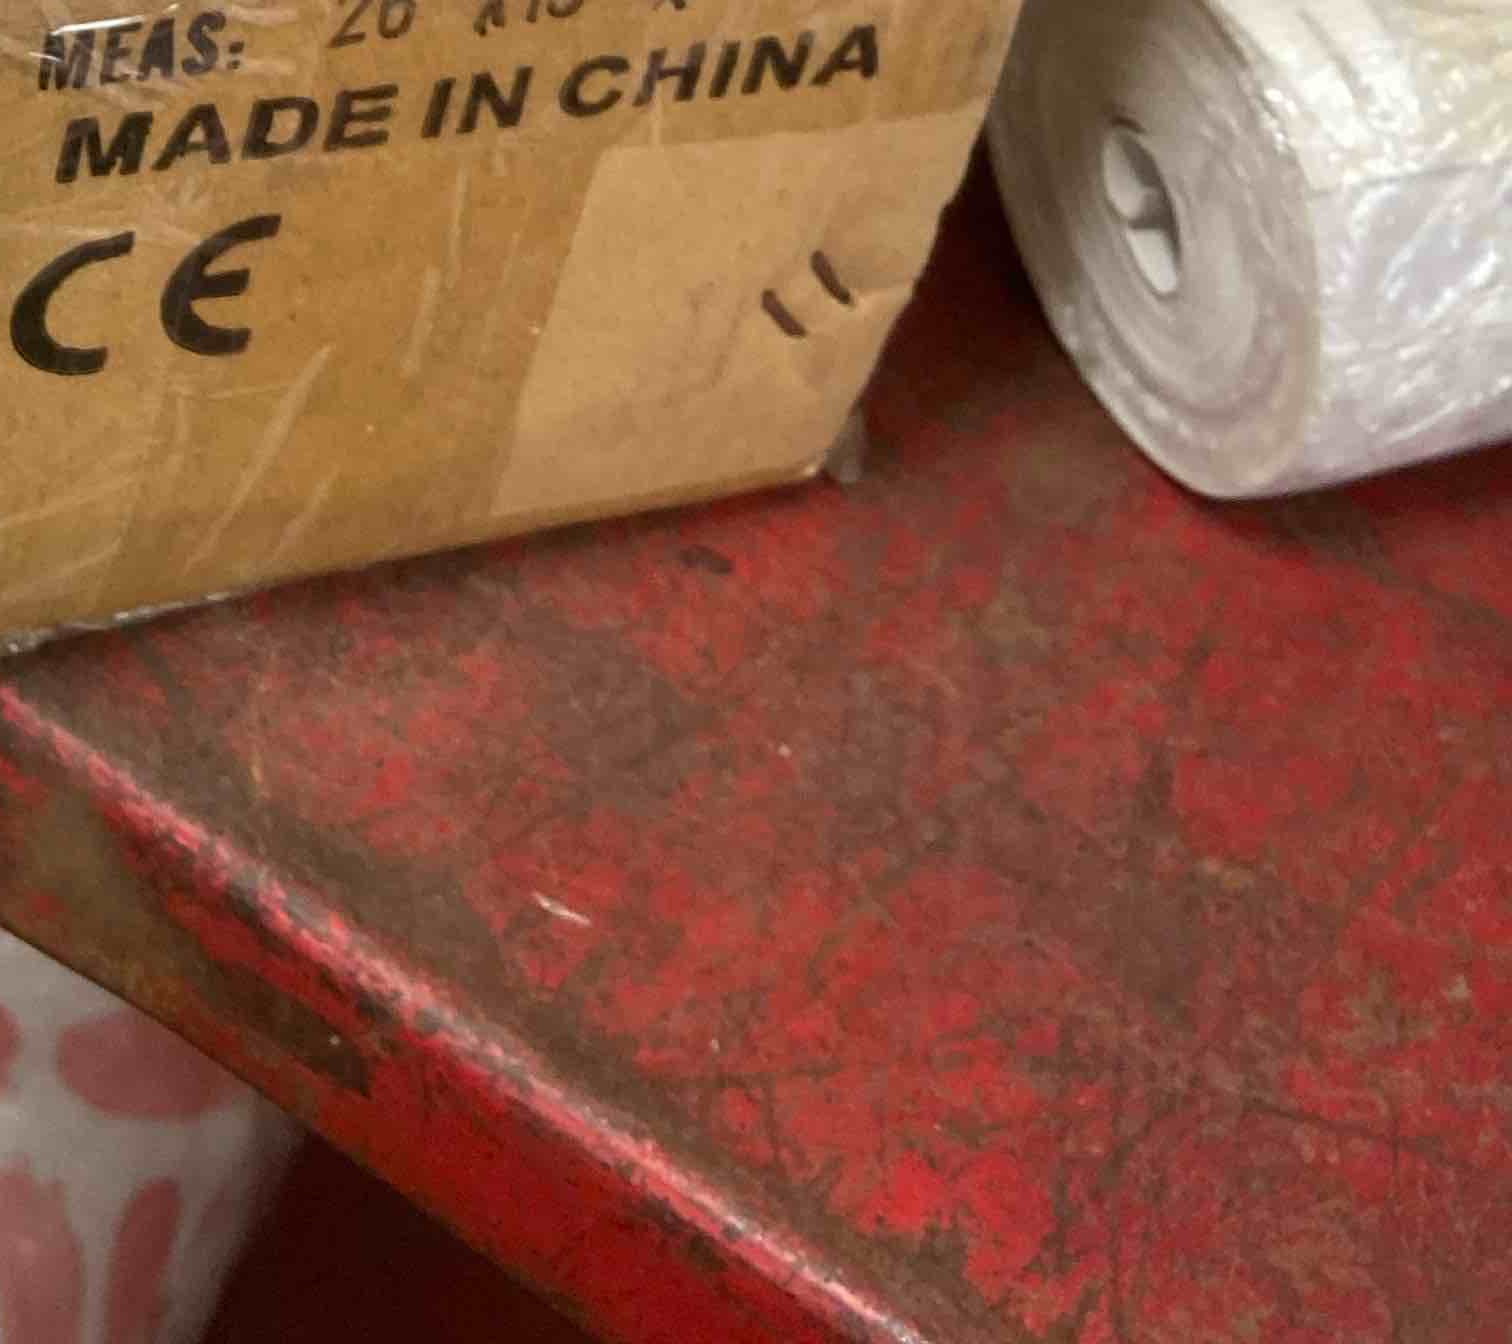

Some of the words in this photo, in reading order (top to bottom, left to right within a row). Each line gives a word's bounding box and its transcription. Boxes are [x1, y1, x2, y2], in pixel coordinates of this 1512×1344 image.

[38, 10, 245, 91] MEAS:
[55, 83, 399, 185] MADE
[421, 65, 533, 139] IN
[558, 24, 880, 119] CHINA
[10, 213, 282, 376] CE
